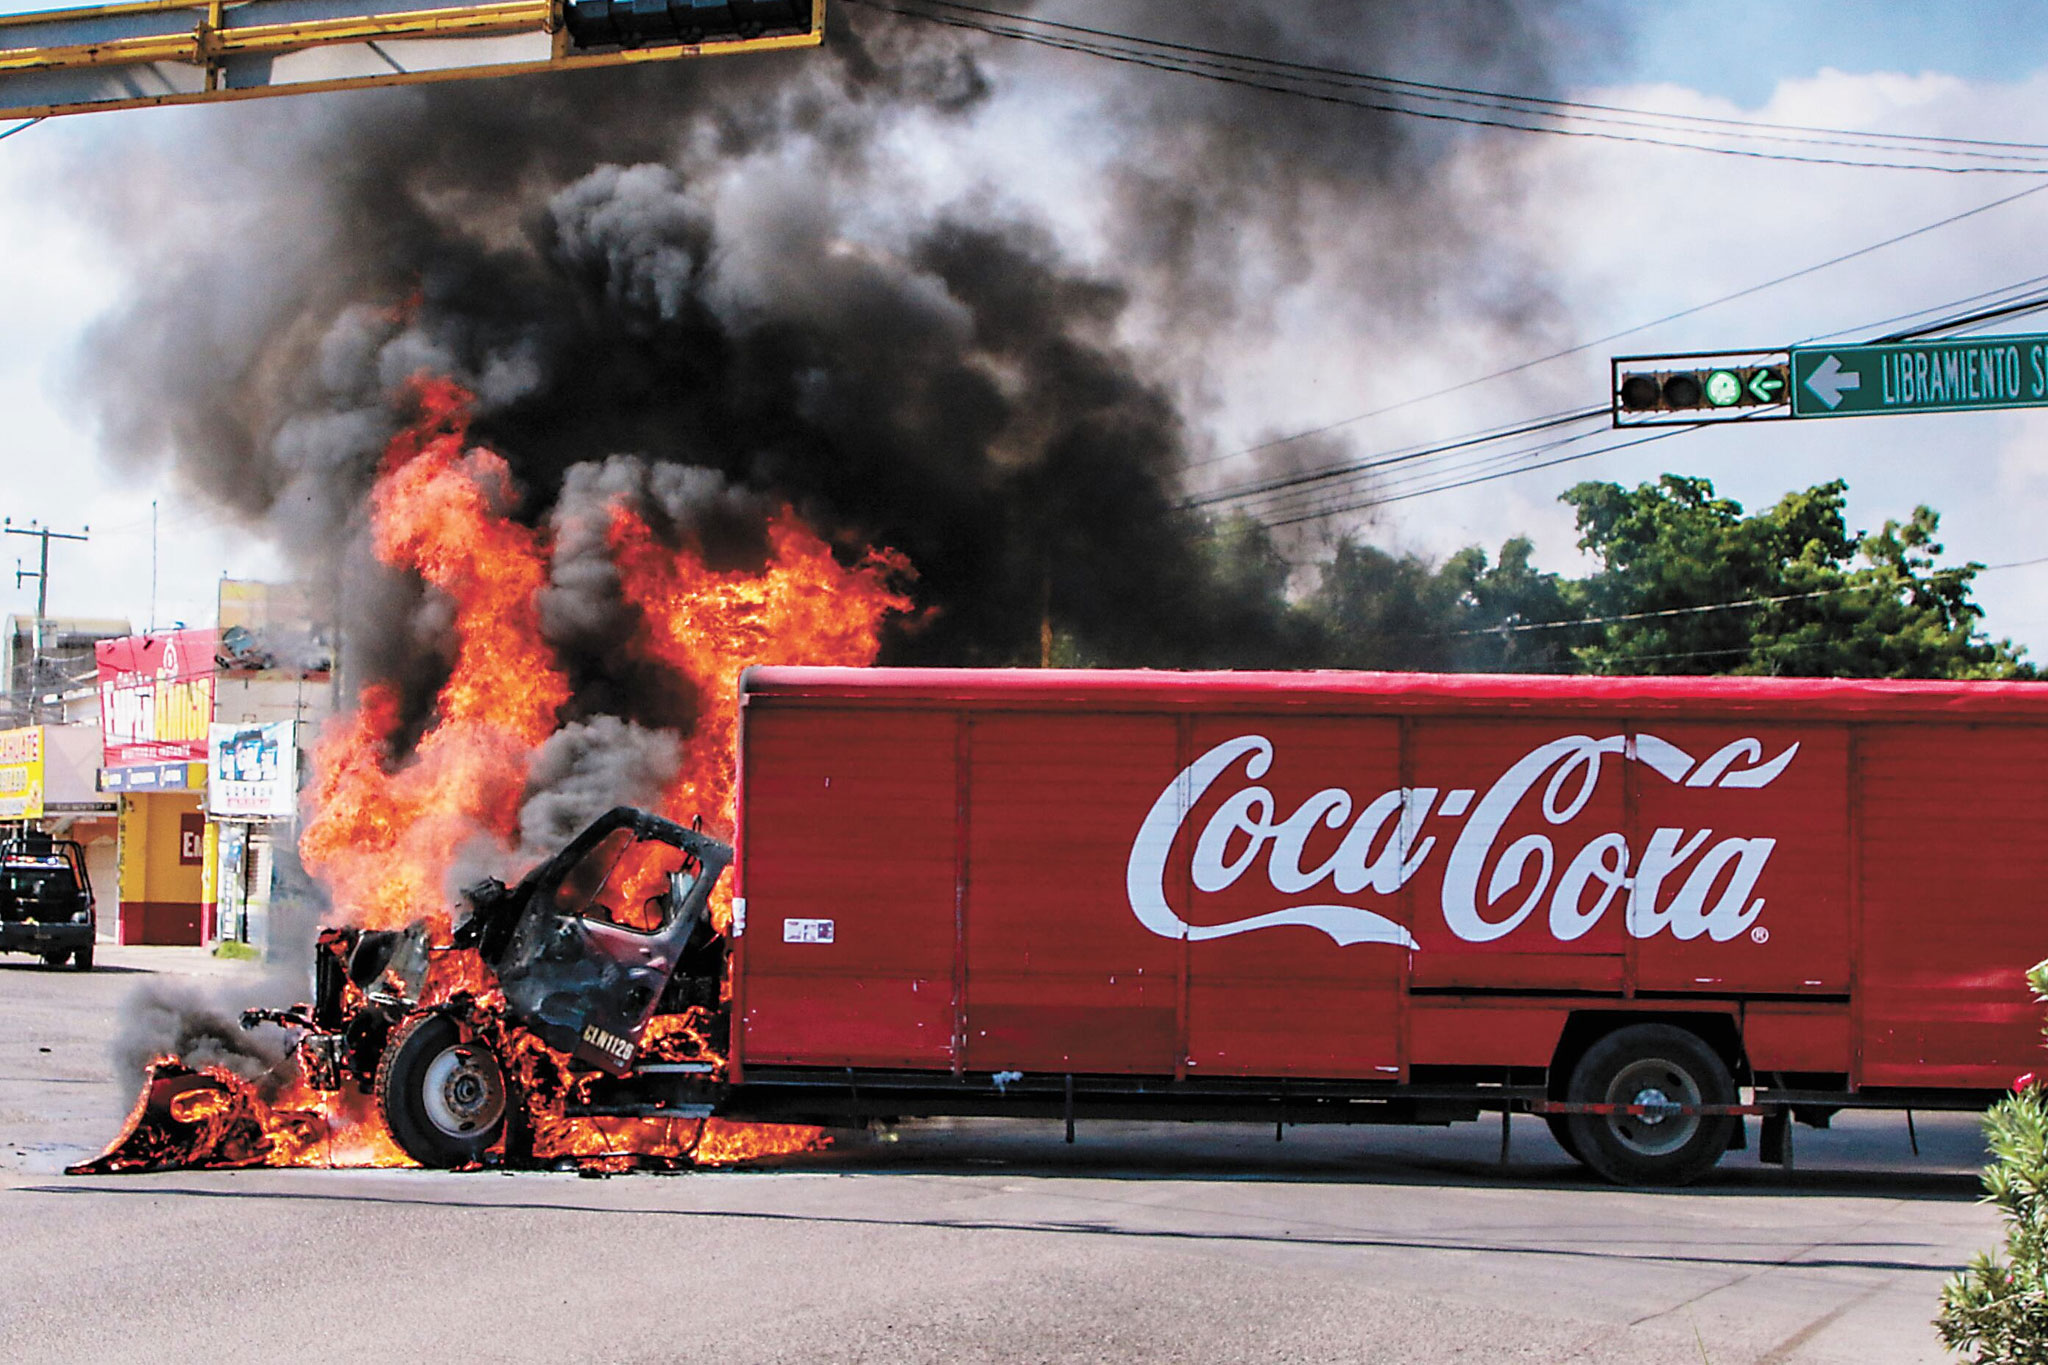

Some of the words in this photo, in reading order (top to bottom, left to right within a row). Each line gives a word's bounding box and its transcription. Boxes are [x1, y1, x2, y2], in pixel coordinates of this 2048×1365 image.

[1881, 346, 2020, 404] LIBRAMIENTO
[2030, 344, 2048, 398] S
[1126, 733, 1800, 950] Coca-Cola
